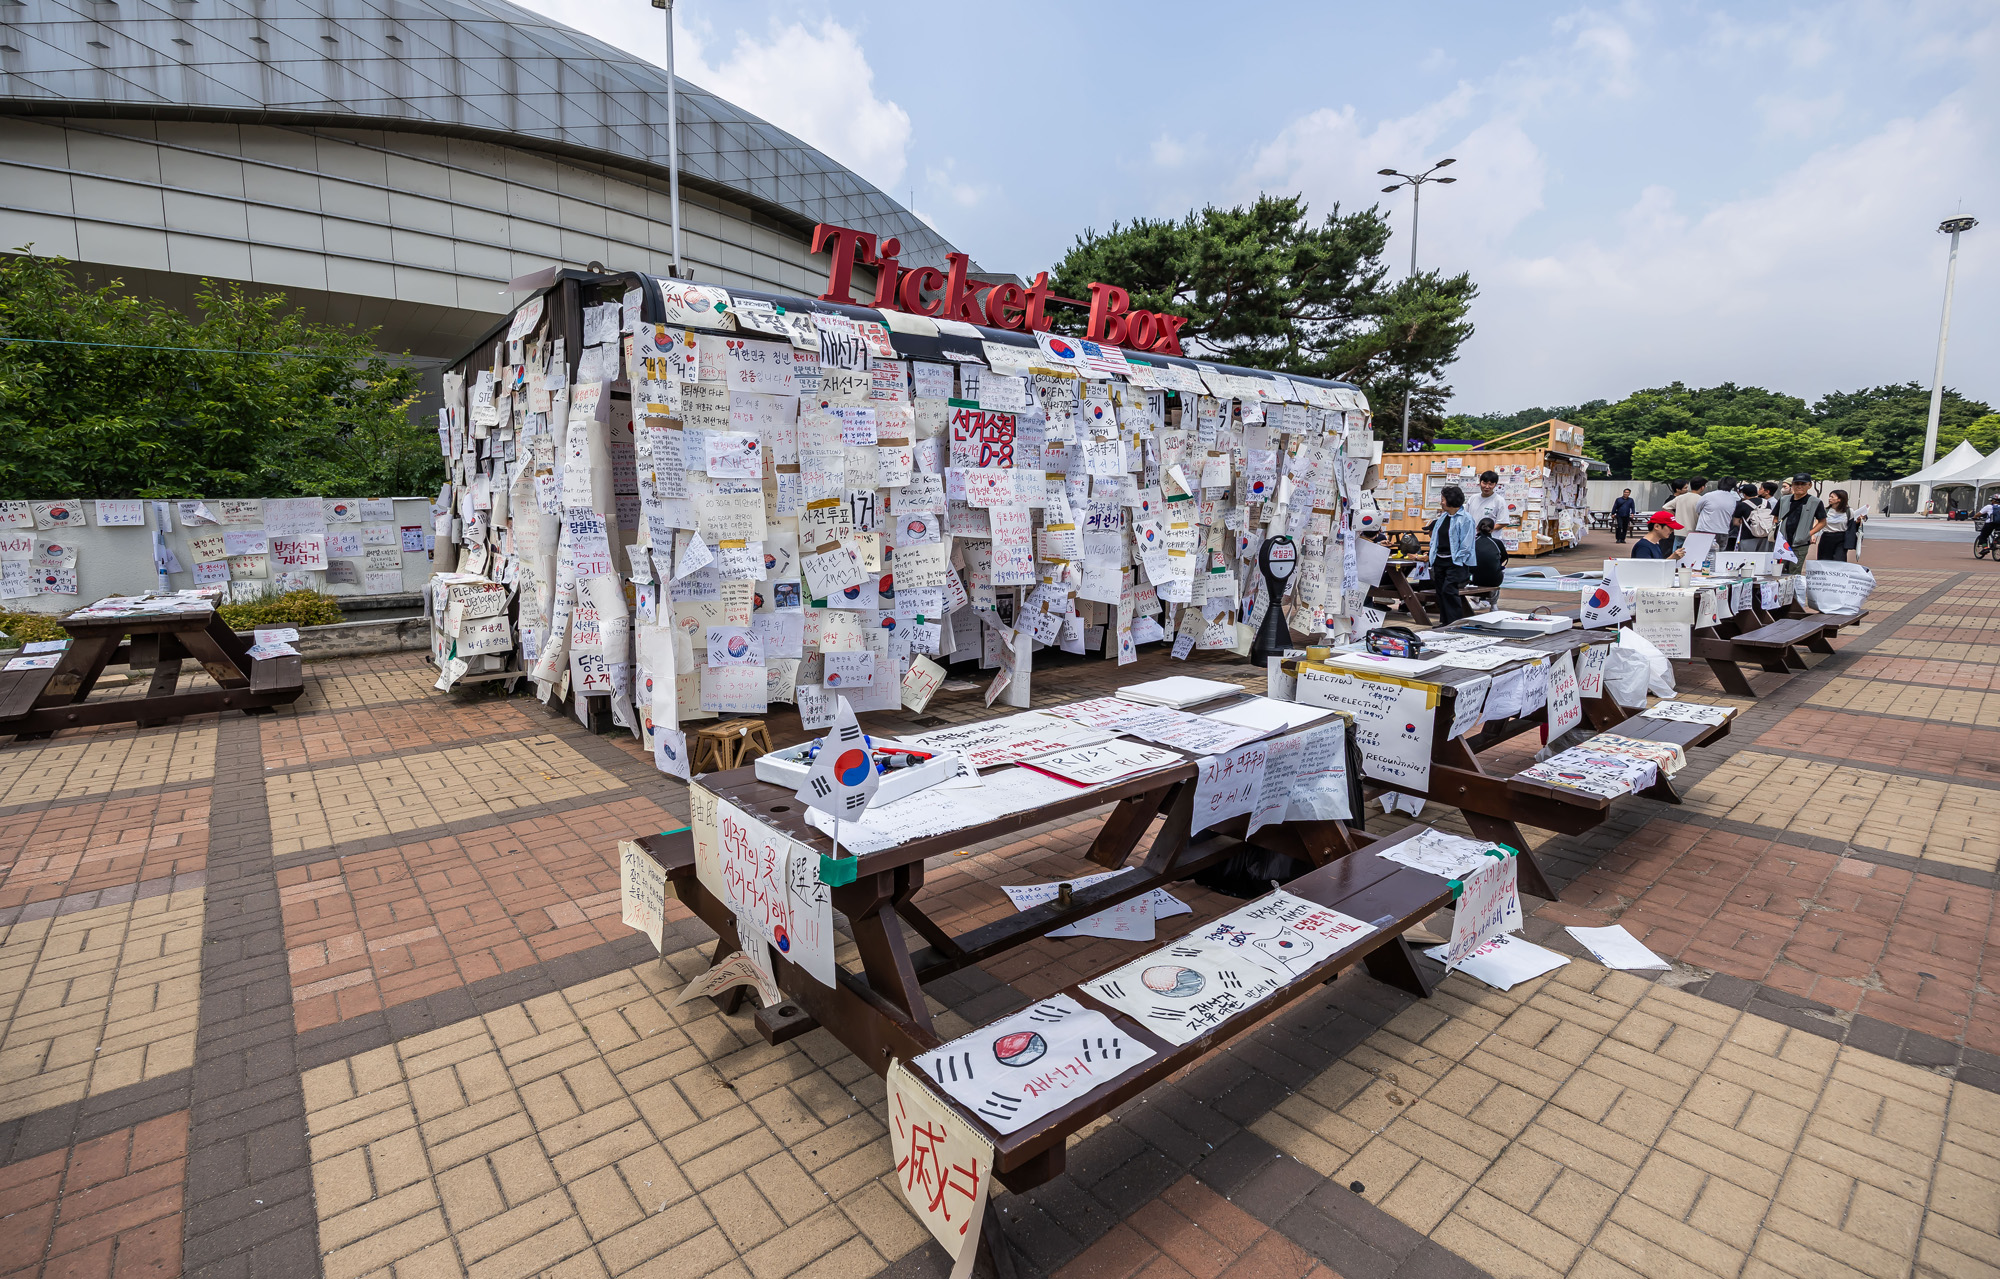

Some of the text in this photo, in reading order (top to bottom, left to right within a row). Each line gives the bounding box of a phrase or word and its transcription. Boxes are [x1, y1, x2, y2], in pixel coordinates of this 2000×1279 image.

[811, 223, 1188, 357] Ticket Box
[729, 348, 791, 365] 대한민국 청년
[818, 329, 867, 370] 재선거
[823, 376, 869, 395] 재선거
[1085, 385, 1108, 395] 부정선거
[953, 408, 1017, 444] 선거소청
[980, 442, 1014, 468] D-8
[901, 487, 922, 495] Great
[99, 504, 118, 512] 우리
[801, 508, 851, 524] 사전투표
[570, 521, 599, 533] 당일투표
[1087, 513, 1119, 529] 재선거
[194, 537, 224, 549] 부정선거
[275, 540, 320, 556] 부정선거
[197, 563, 226, 572] 부정선거
[278, 554, 320, 565] 재선거
[806, 547, 854, 574] 부정선거
[817, 566, 862, 589] 재선거
[452, 583, 504, 598] PLEASE SAVE
[1578, 673, 1601, 694] 선거
[1033, 746, 1118, 770] TRUST
[1071, 747, 1167, 777] THE PLAN
[723, 816, 779, 894] 민주주의 꽃
[1024, 1056, 1093, 1098] 재선거
